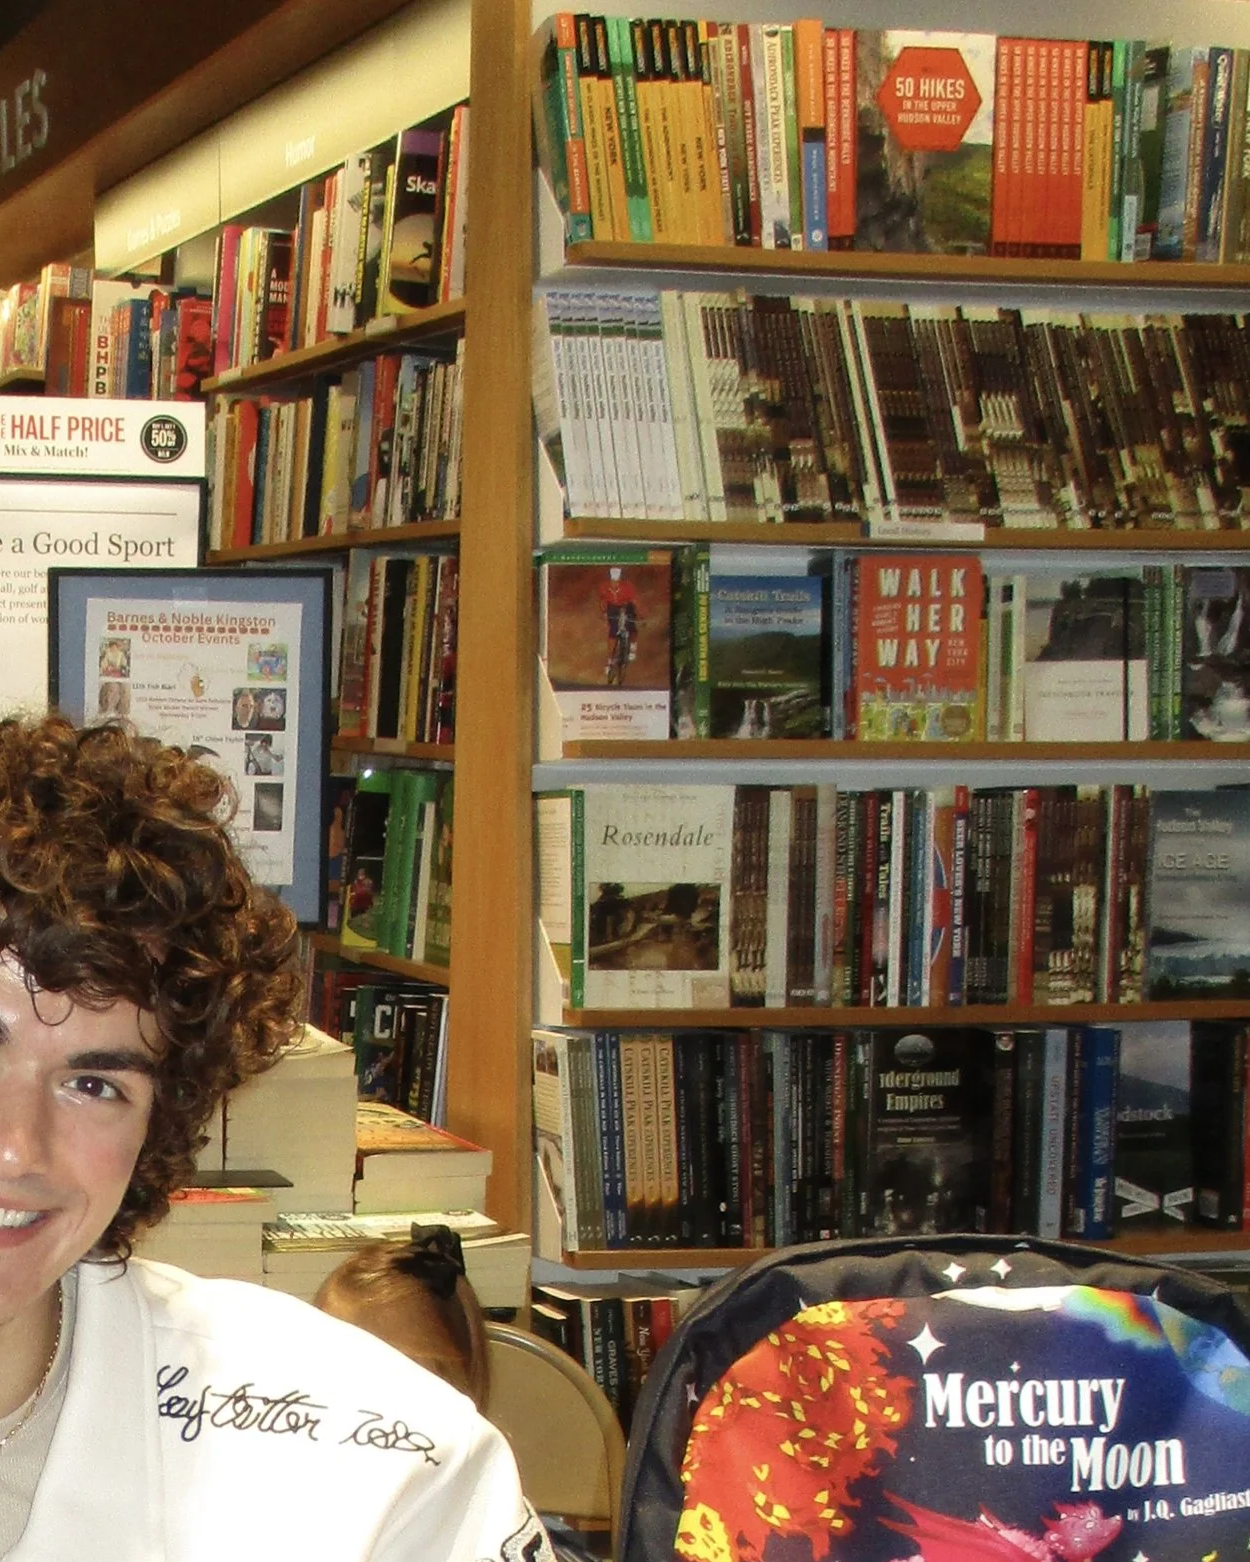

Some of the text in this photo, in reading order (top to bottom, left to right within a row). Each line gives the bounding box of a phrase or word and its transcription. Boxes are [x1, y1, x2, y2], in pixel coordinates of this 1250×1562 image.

[895, 77, 965, 99] 50 HIKES
[898, 113, 962, 125] HUDSON VALLEY
[914, 101, 929, 111] THE
[931, 101, 957, 112] UPPER
[11, 414, 61, 440] HALF
[67, 416, 125, 442] PRICE
[4, 444, 88, 458] Mix & Match!
[11, 537, 25, 554] a
[33, 532, 99, 555] Good
[107, 534, 175, 562] Sport
[18, 583, 38, 595] golf
[878, 568, 967, 598] WALK
[18, 613, 29, 623] of
[107, 612, 276, 629] Barnes & Noble Kingston
[906, 603, 965, 633] HER
[142, 632, 240, 645] October Events
[877, 638, 941, 668] WAY
[602, 824, 715, 847] Rosendale
[878, 803, 890, 899] Trails Tales
[623, 1047, 634, 1096] CATSKILL
[641, 1047, 652, 1096] CATSKILL
[659, 1047, 670, 1098] CATSKILL
[626, 1100, 635, 1127] PEAK
[643, 1100, 653, 1126] PEAK
[661, 1100, 672, 1127] PEAK
[886, 1092, 944, 1112] Empires
[923, 1371, 1125, 1434] Mercury
[984, 1430, 1186, 1493] to the Moon
[1143, 1498, 1175, 1520] J.Q.
[1180, 1489, 1250, 1517] Gagliast
